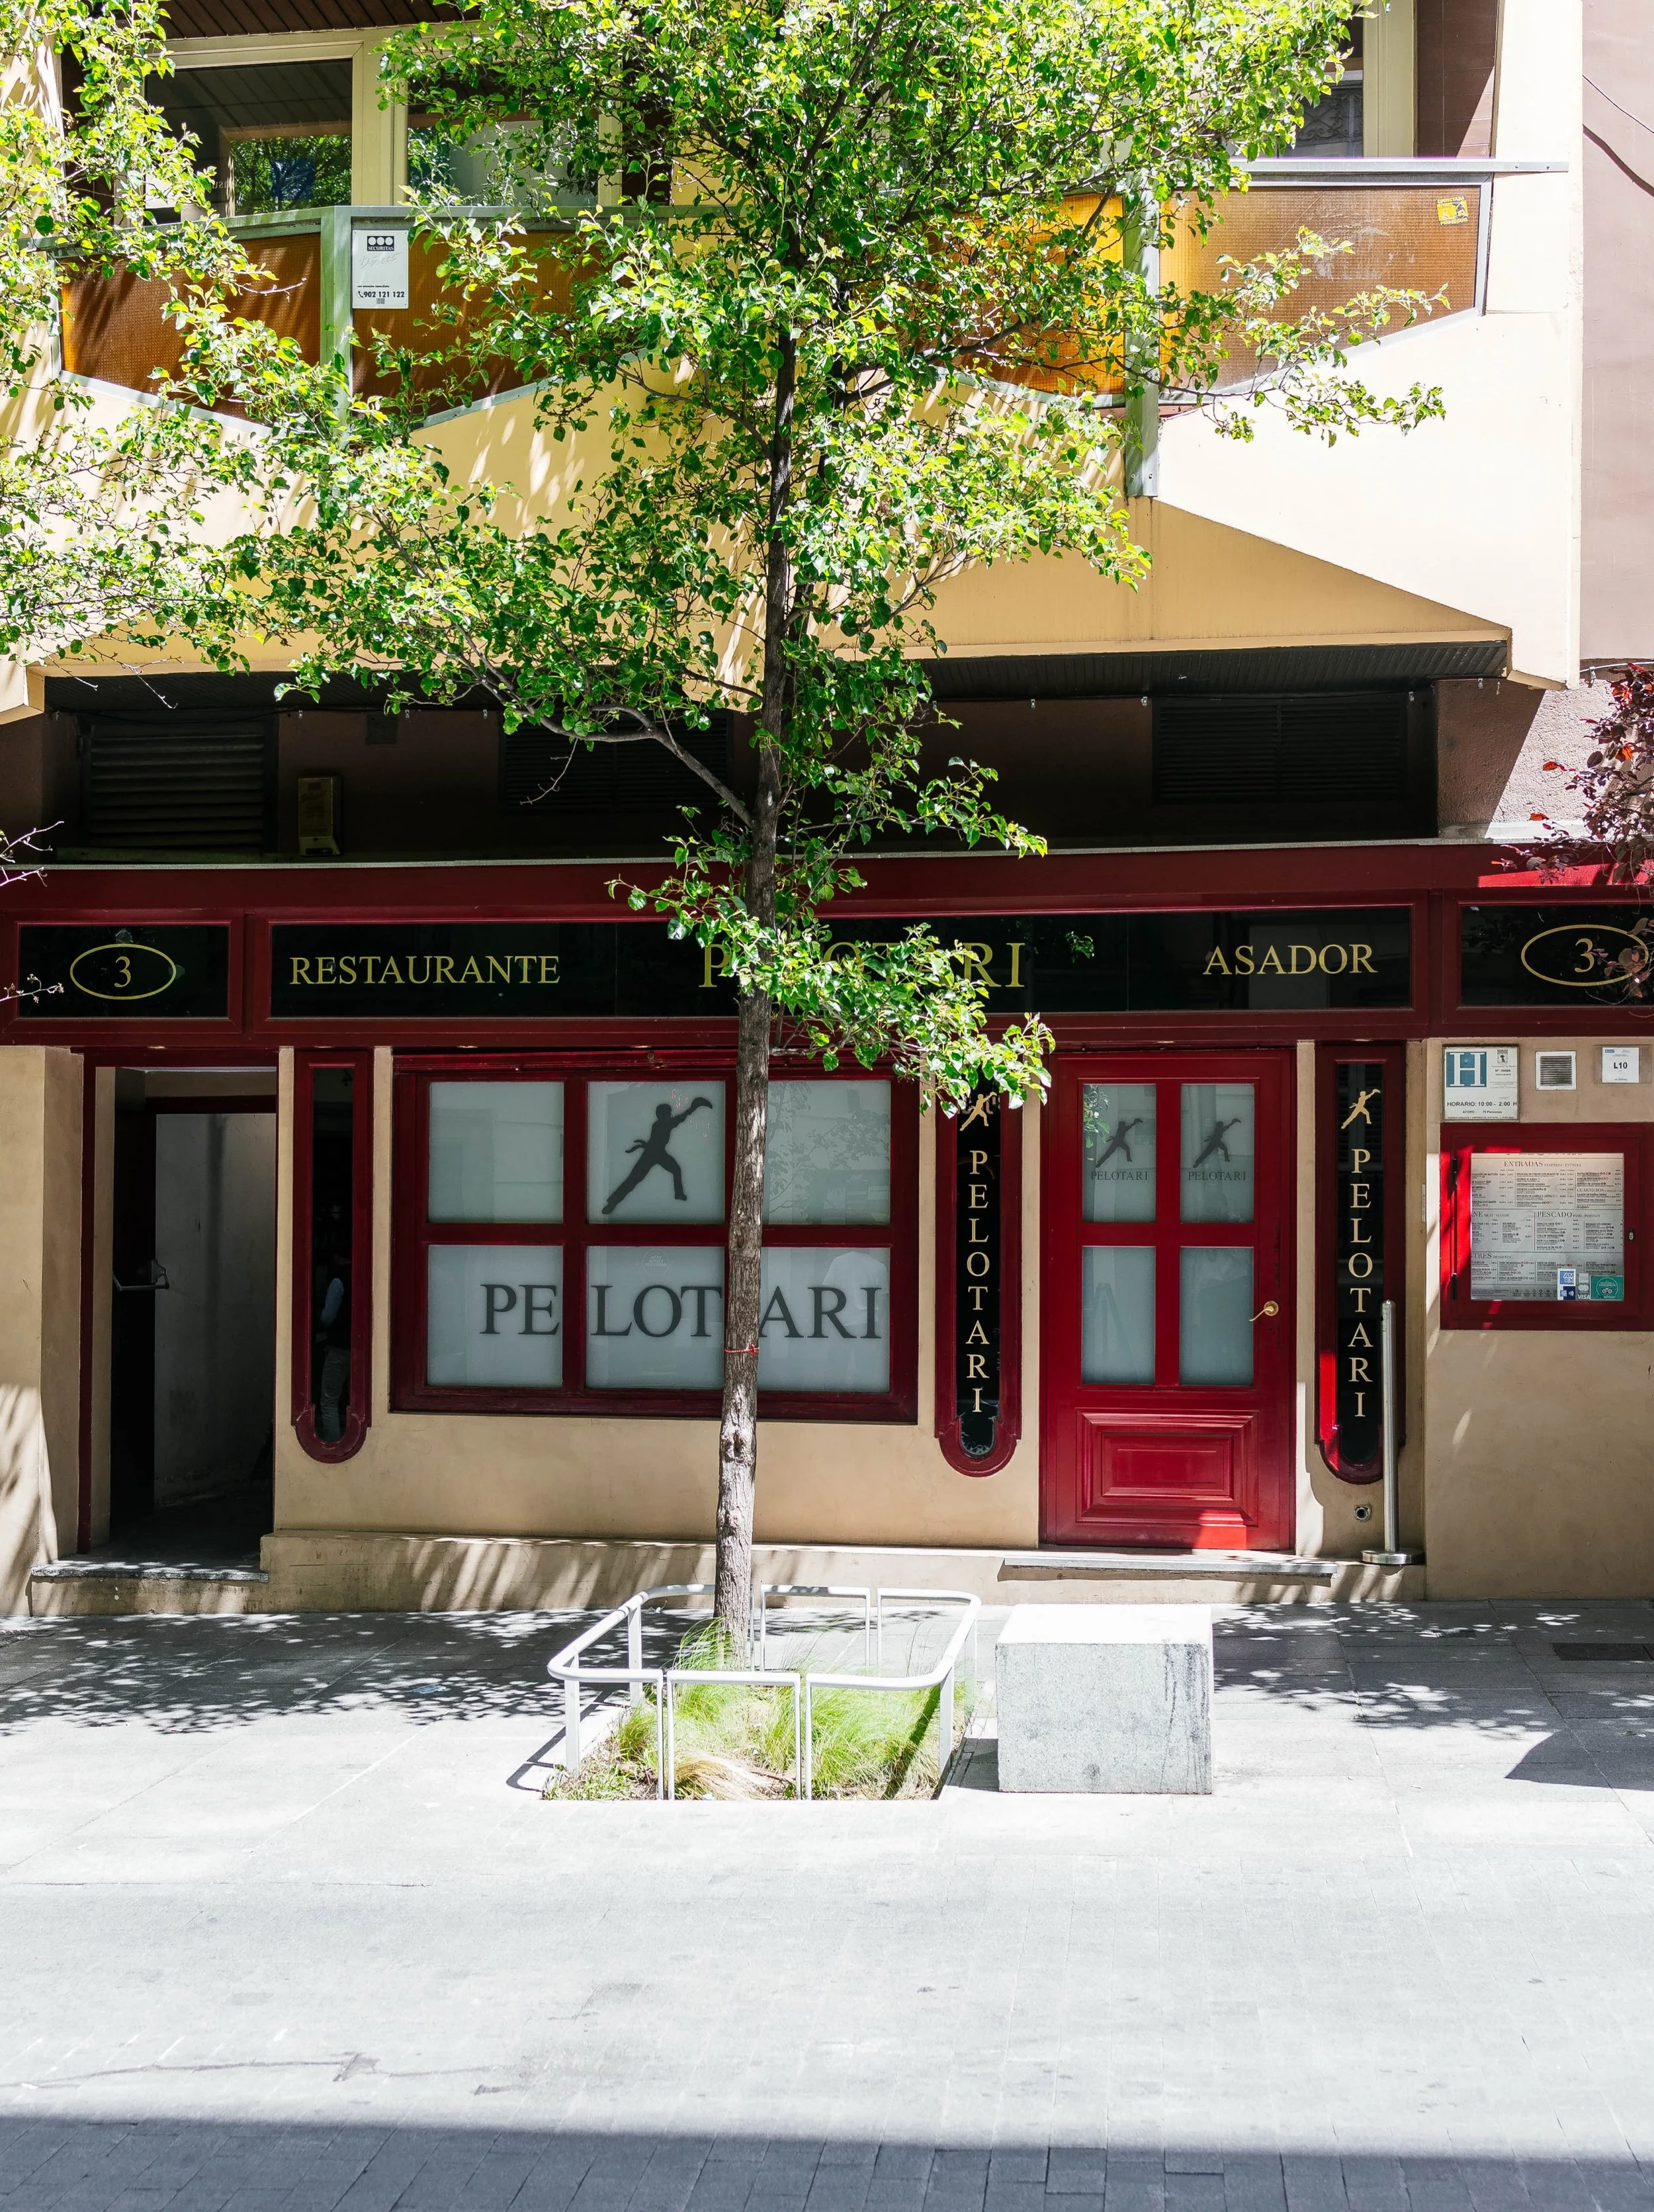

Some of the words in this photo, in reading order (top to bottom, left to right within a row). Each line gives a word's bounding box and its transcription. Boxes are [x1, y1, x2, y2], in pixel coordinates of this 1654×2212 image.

[290, 955, 561, 984] RESTAURANTE
[1202, 943, 1378, 975] ASADOR
[1575, 938, 1594, 973] 3
[113, 957, 132, 988] 3
[1091, 1171, 1149, 1181] PELOTARI
[1188, 1171, 1246, 1181] PELOTARI
[966, 1150, 991, 1413] PELOTARI
[1348, 1149, 1374, 1418] PELOTARI
